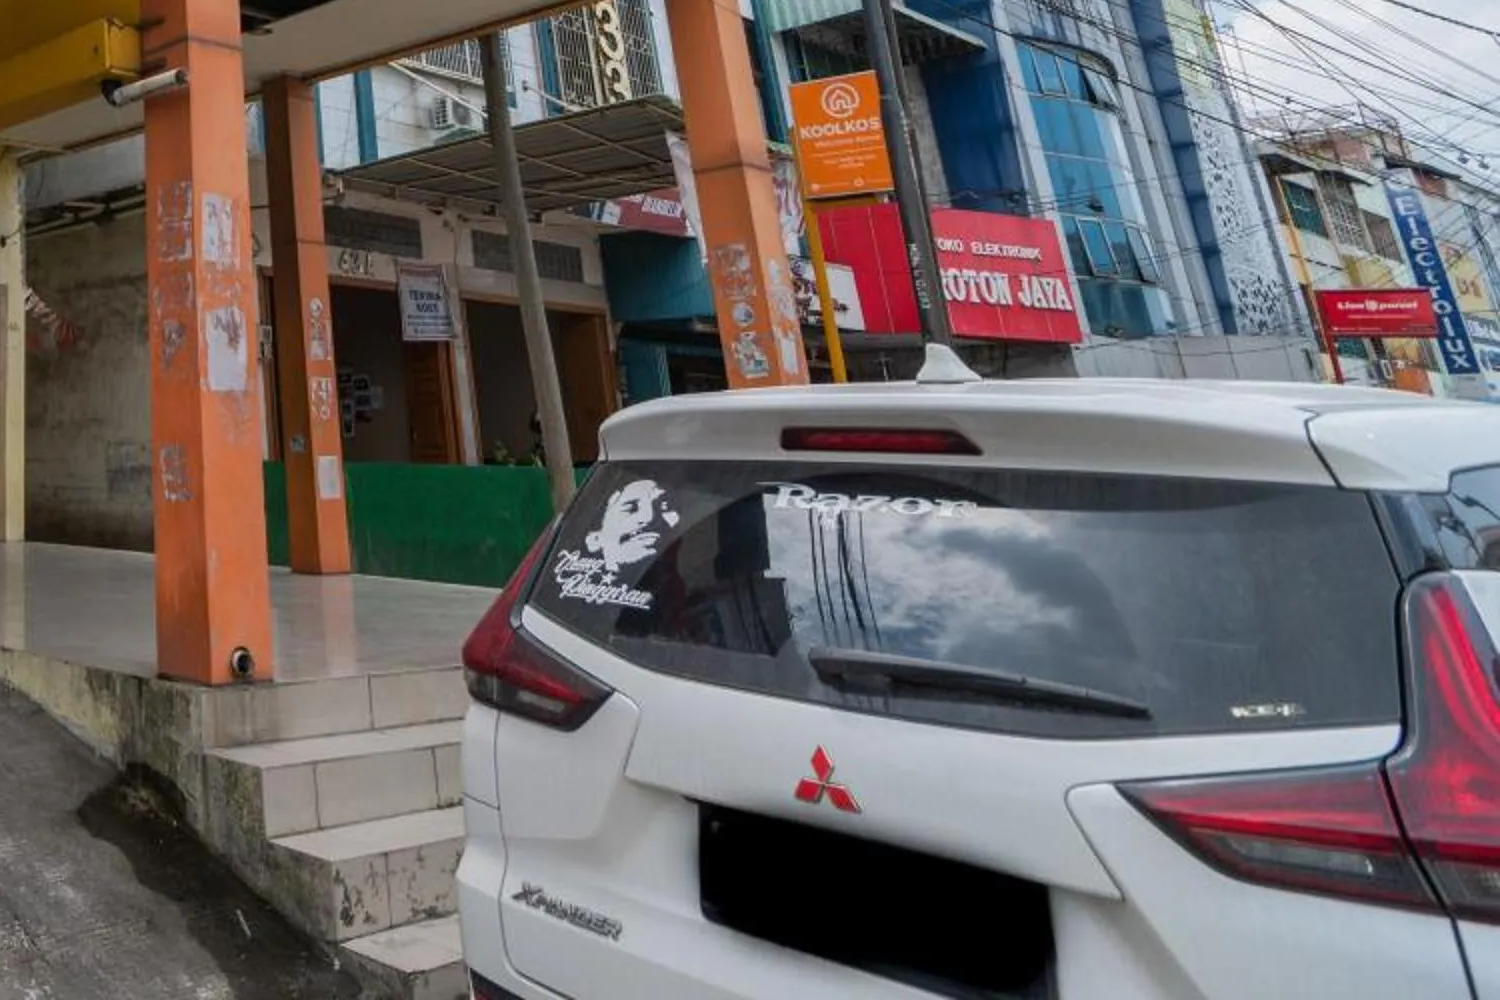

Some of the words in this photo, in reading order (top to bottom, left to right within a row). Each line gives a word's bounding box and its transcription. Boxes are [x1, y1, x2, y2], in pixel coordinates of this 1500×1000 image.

[799, 116, 882, 139] KOOLKOS
[933, 237, 964, 253] OKO
[1017, 273, 1073, 312] JAYA
[1395, 195, 1472, 369] Electrolux
[756, 480, 978, 518] Razor
